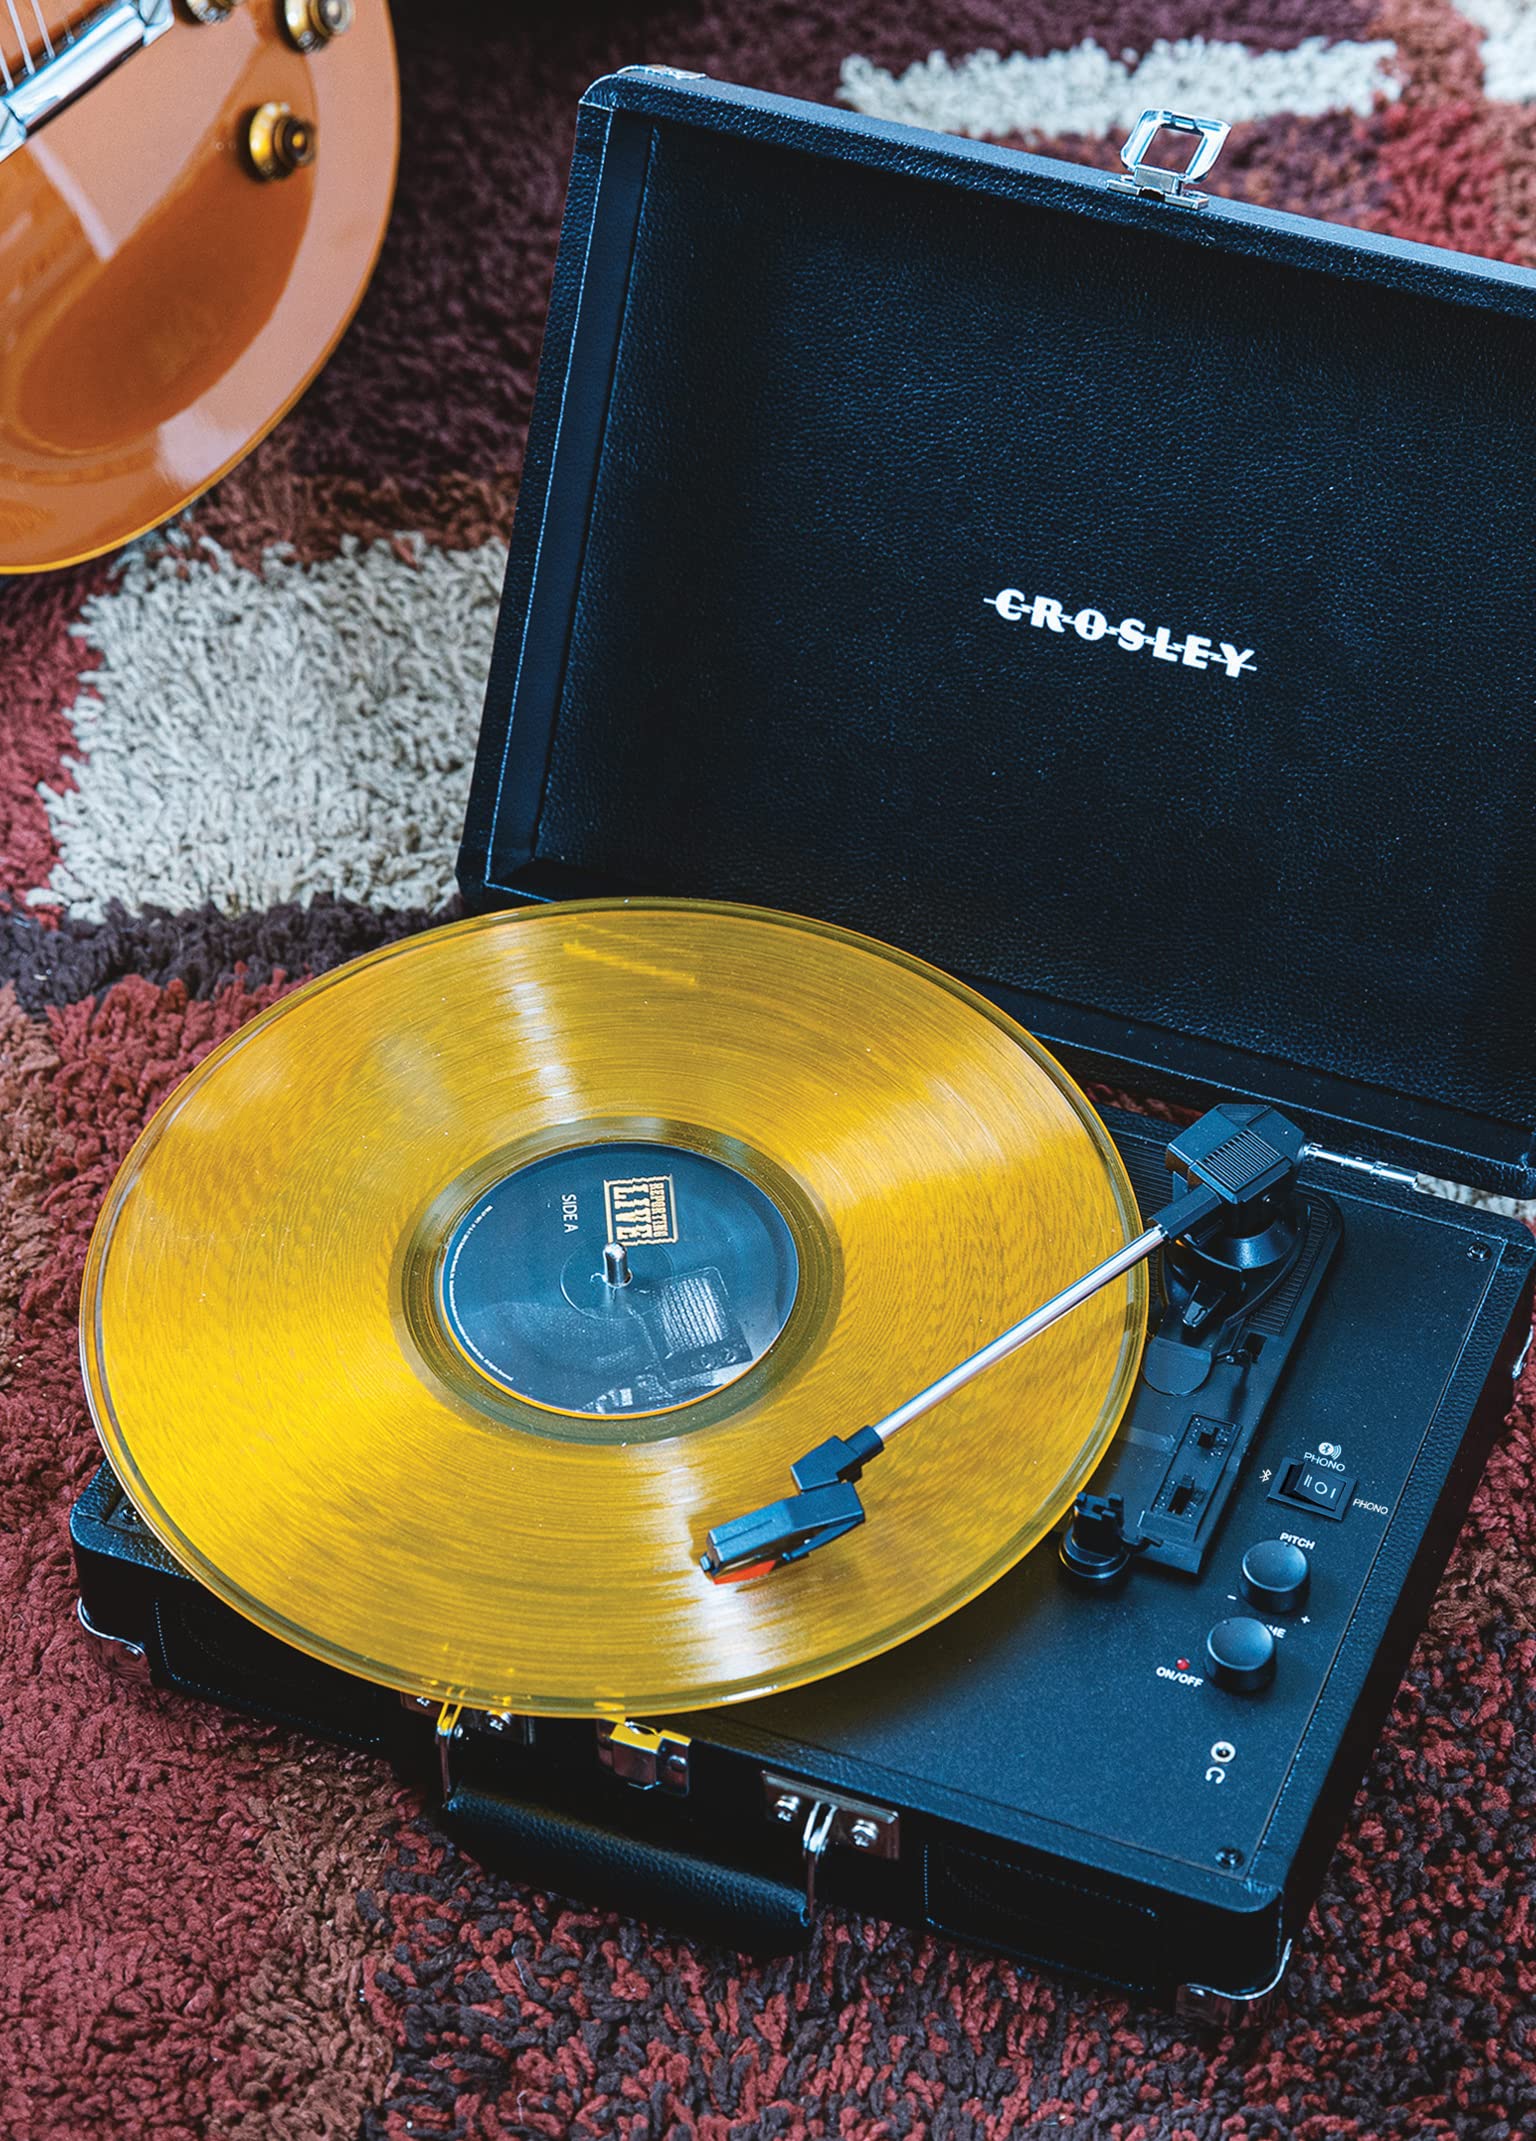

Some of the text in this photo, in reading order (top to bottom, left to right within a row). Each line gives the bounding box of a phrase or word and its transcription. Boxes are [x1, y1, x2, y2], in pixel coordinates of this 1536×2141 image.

[986, 588, 1257, 678] CROSLEY
[561, 1193, 579, 1234] SIDE A
[613, 1183, 654, 1240] LIVE
[648, 1182, 669, 1238] REPORTING
[1303, 1451, 1346, 1472] PHONO
[1352, 1498, 1389, 1515] PHONO
[1279, 1532, 1316, 1550] PITCH
[1155, 1666, 1204, 1688] ON/OFF
